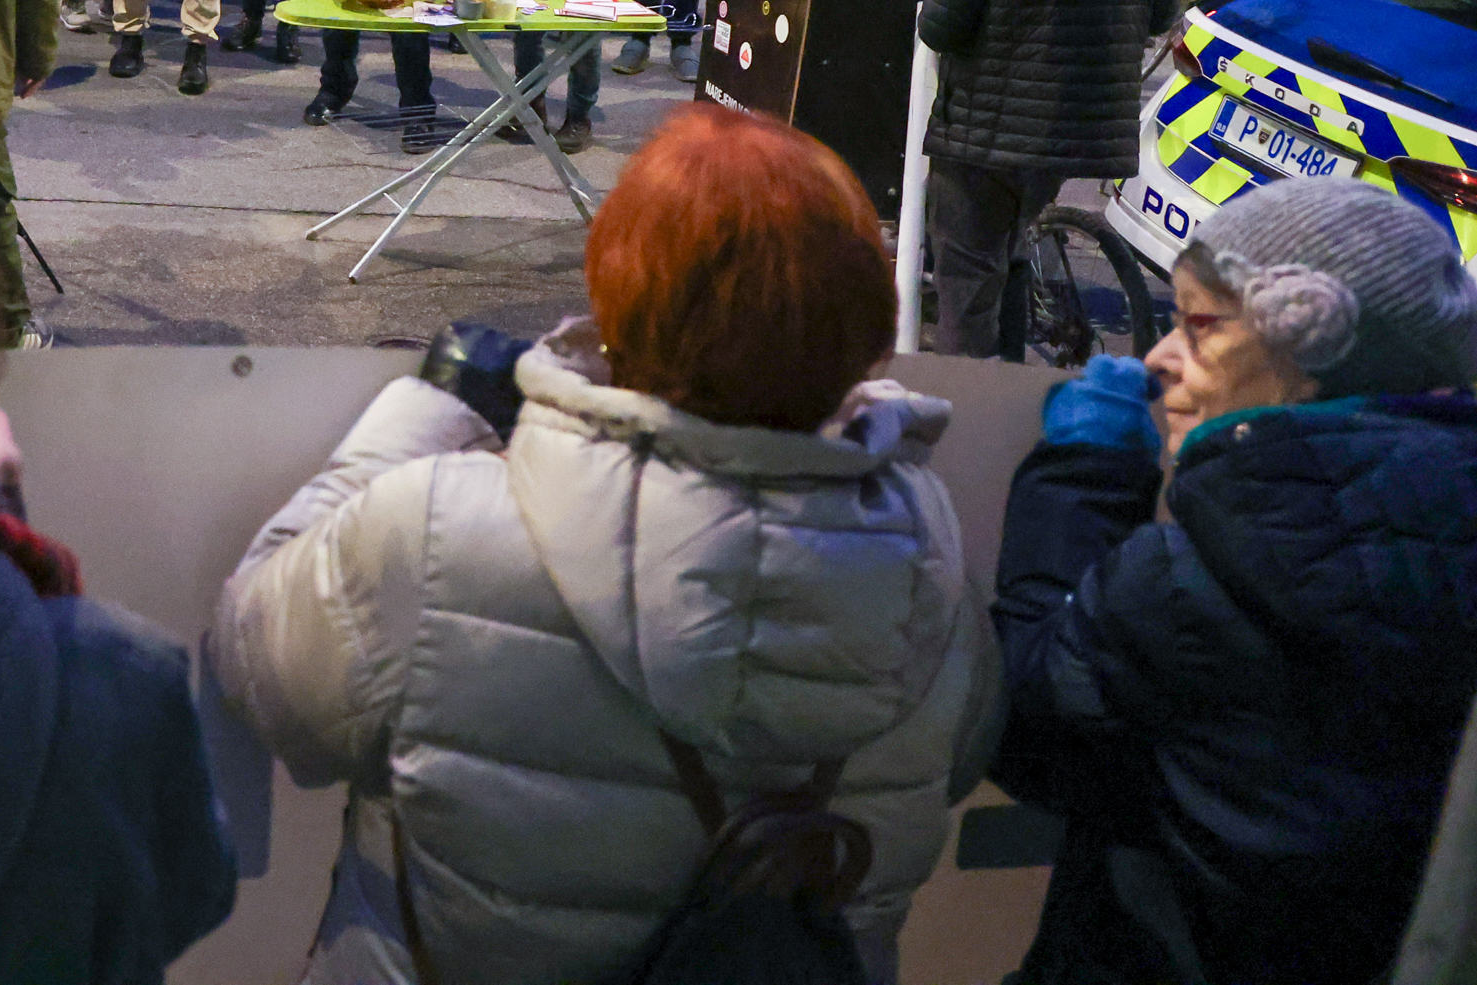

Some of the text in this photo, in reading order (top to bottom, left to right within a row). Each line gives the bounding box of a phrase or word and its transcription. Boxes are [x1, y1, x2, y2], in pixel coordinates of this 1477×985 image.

[1238, 115, 1258, 142] P
[1268, 129, 1338, 176] 01-484
[1142, 185, 1202, 239] PO
